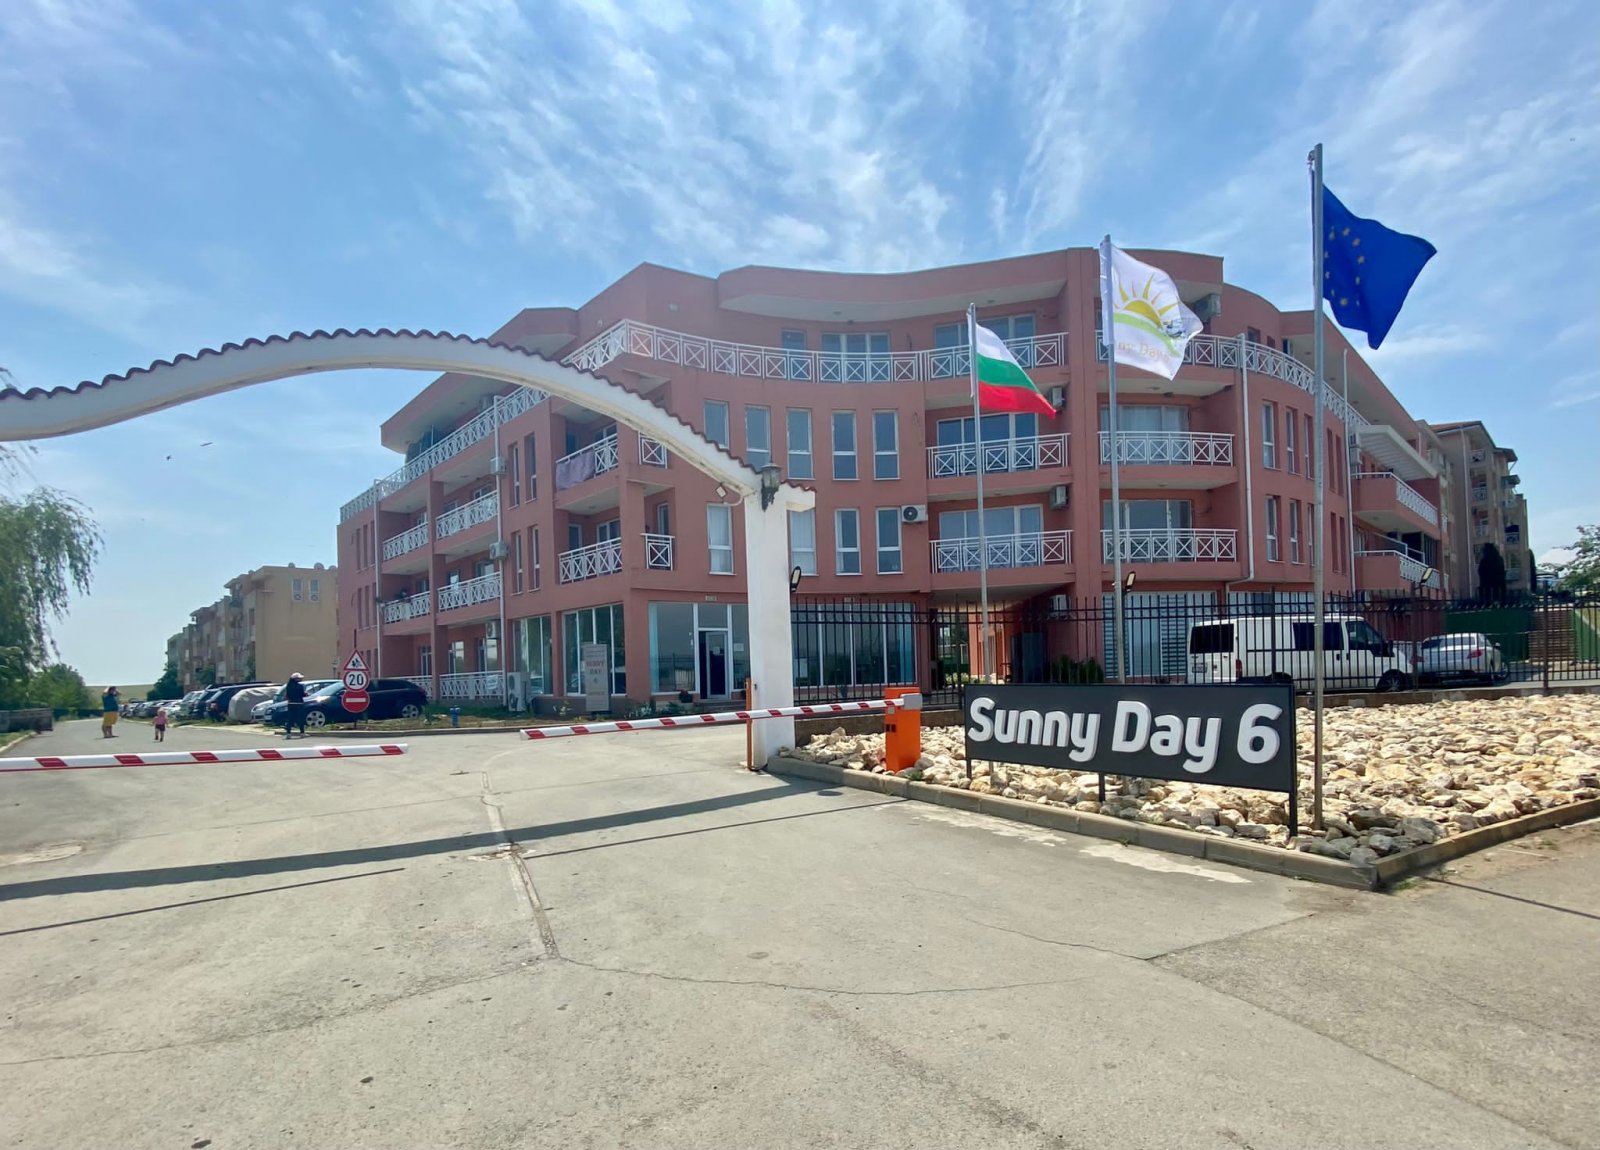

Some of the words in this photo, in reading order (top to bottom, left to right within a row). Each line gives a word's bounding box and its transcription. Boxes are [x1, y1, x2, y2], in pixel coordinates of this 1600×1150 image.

[349, 674, 363, 685] 20
[968, 697, 1101, 762] Sunny
[1112, 701, 1221, 773] Day
[1237, 704, 1283, 764] 6
